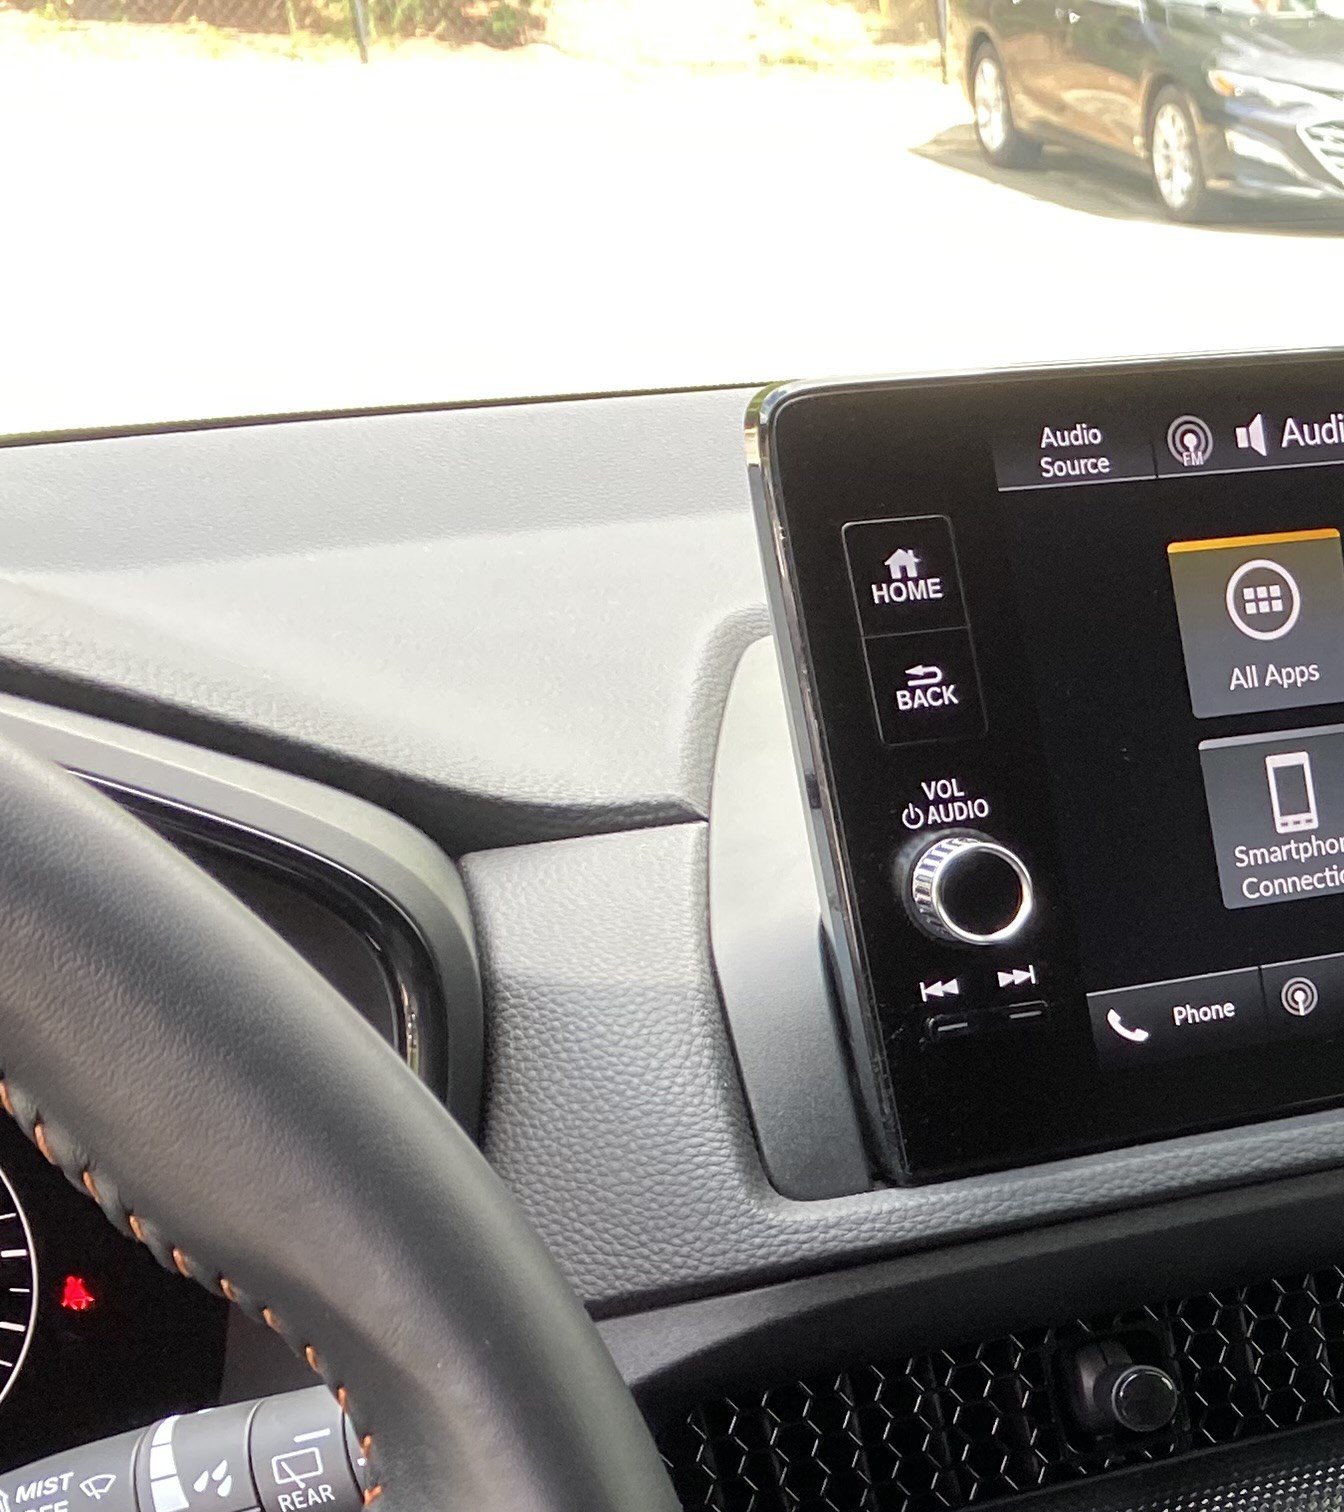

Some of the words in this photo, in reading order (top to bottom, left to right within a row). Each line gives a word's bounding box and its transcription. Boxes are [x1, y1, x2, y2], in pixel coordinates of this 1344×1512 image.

[1040, 422, 1102, 448] Audio
[1040, 453, 1110, 478] Source
[1182, 451, 1205, 467] FM
[871, 577, 943, 604] HOME
[1229, 666, 1260, 691] All
[1264, 663, 1320, 689] Apps
[896, 684, 959, 711] BACK
[921, 778, 965, 802] VOL
[927, 798, 989, 826] AUDIO
[1173, 997, 1236, 1026] Phone
[15, 1472, 75, 1504] MIST
[277, 1484, 336, 1512] REAR
